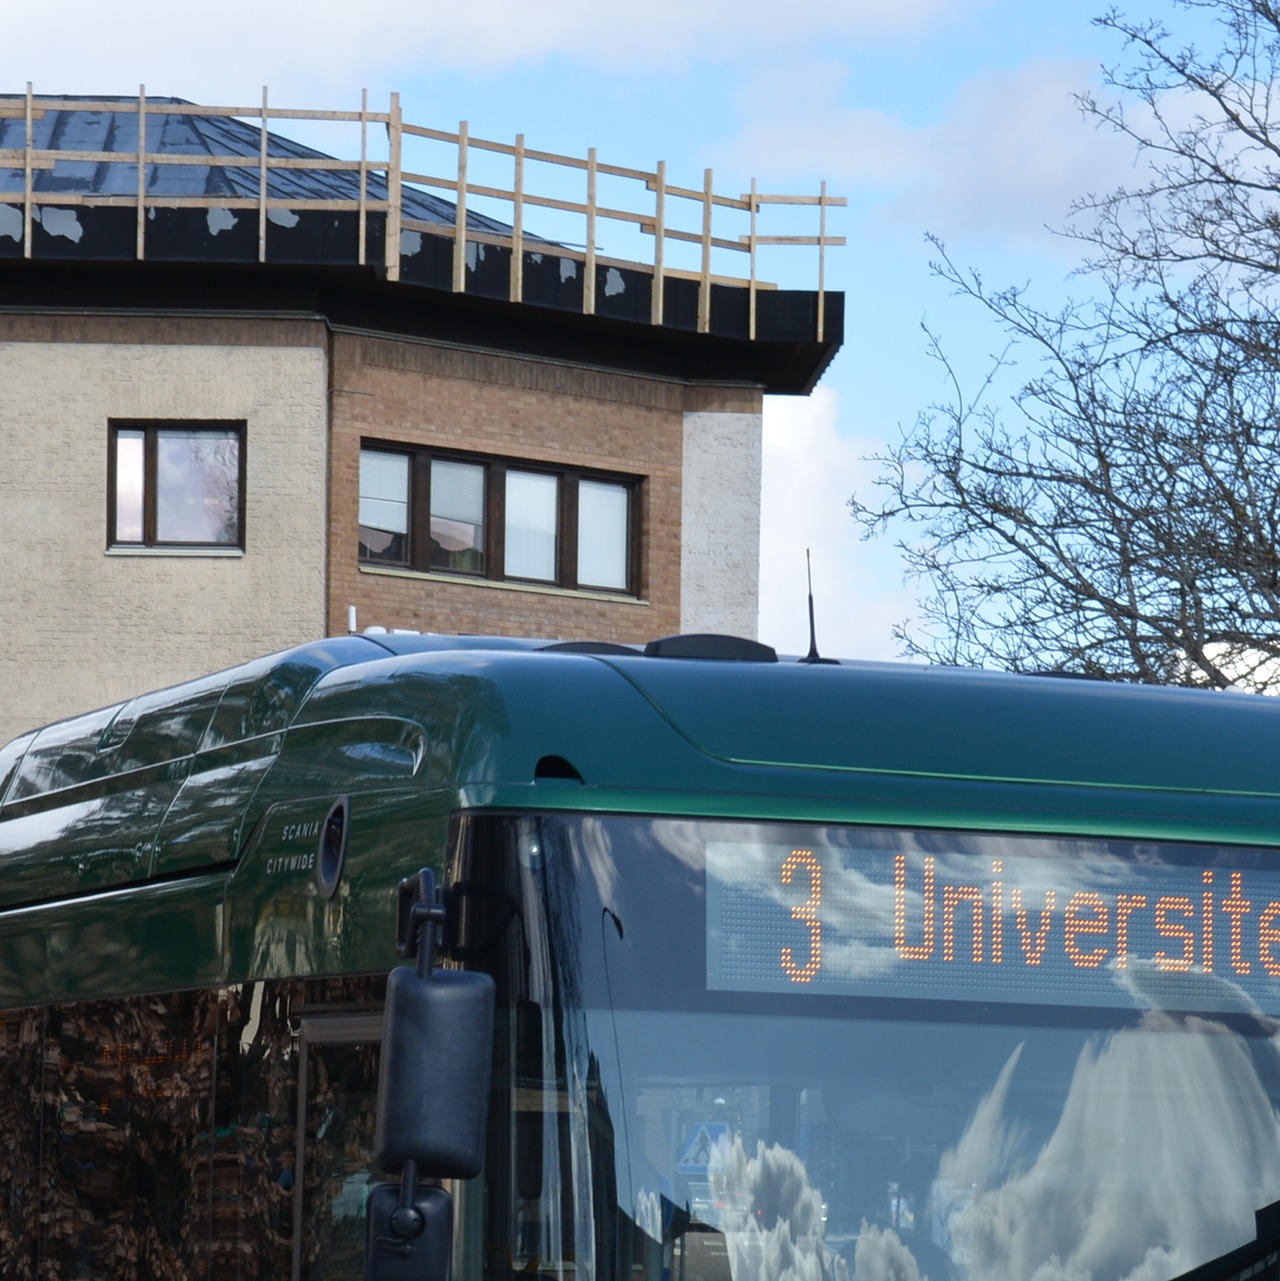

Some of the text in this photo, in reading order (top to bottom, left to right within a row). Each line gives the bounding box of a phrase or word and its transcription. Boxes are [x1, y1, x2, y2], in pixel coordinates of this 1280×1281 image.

[281, 821, 319, 841] SCANIA
[266, 853, 315, 874] CITYWIDE
[780, 848, 821, 983] 3
